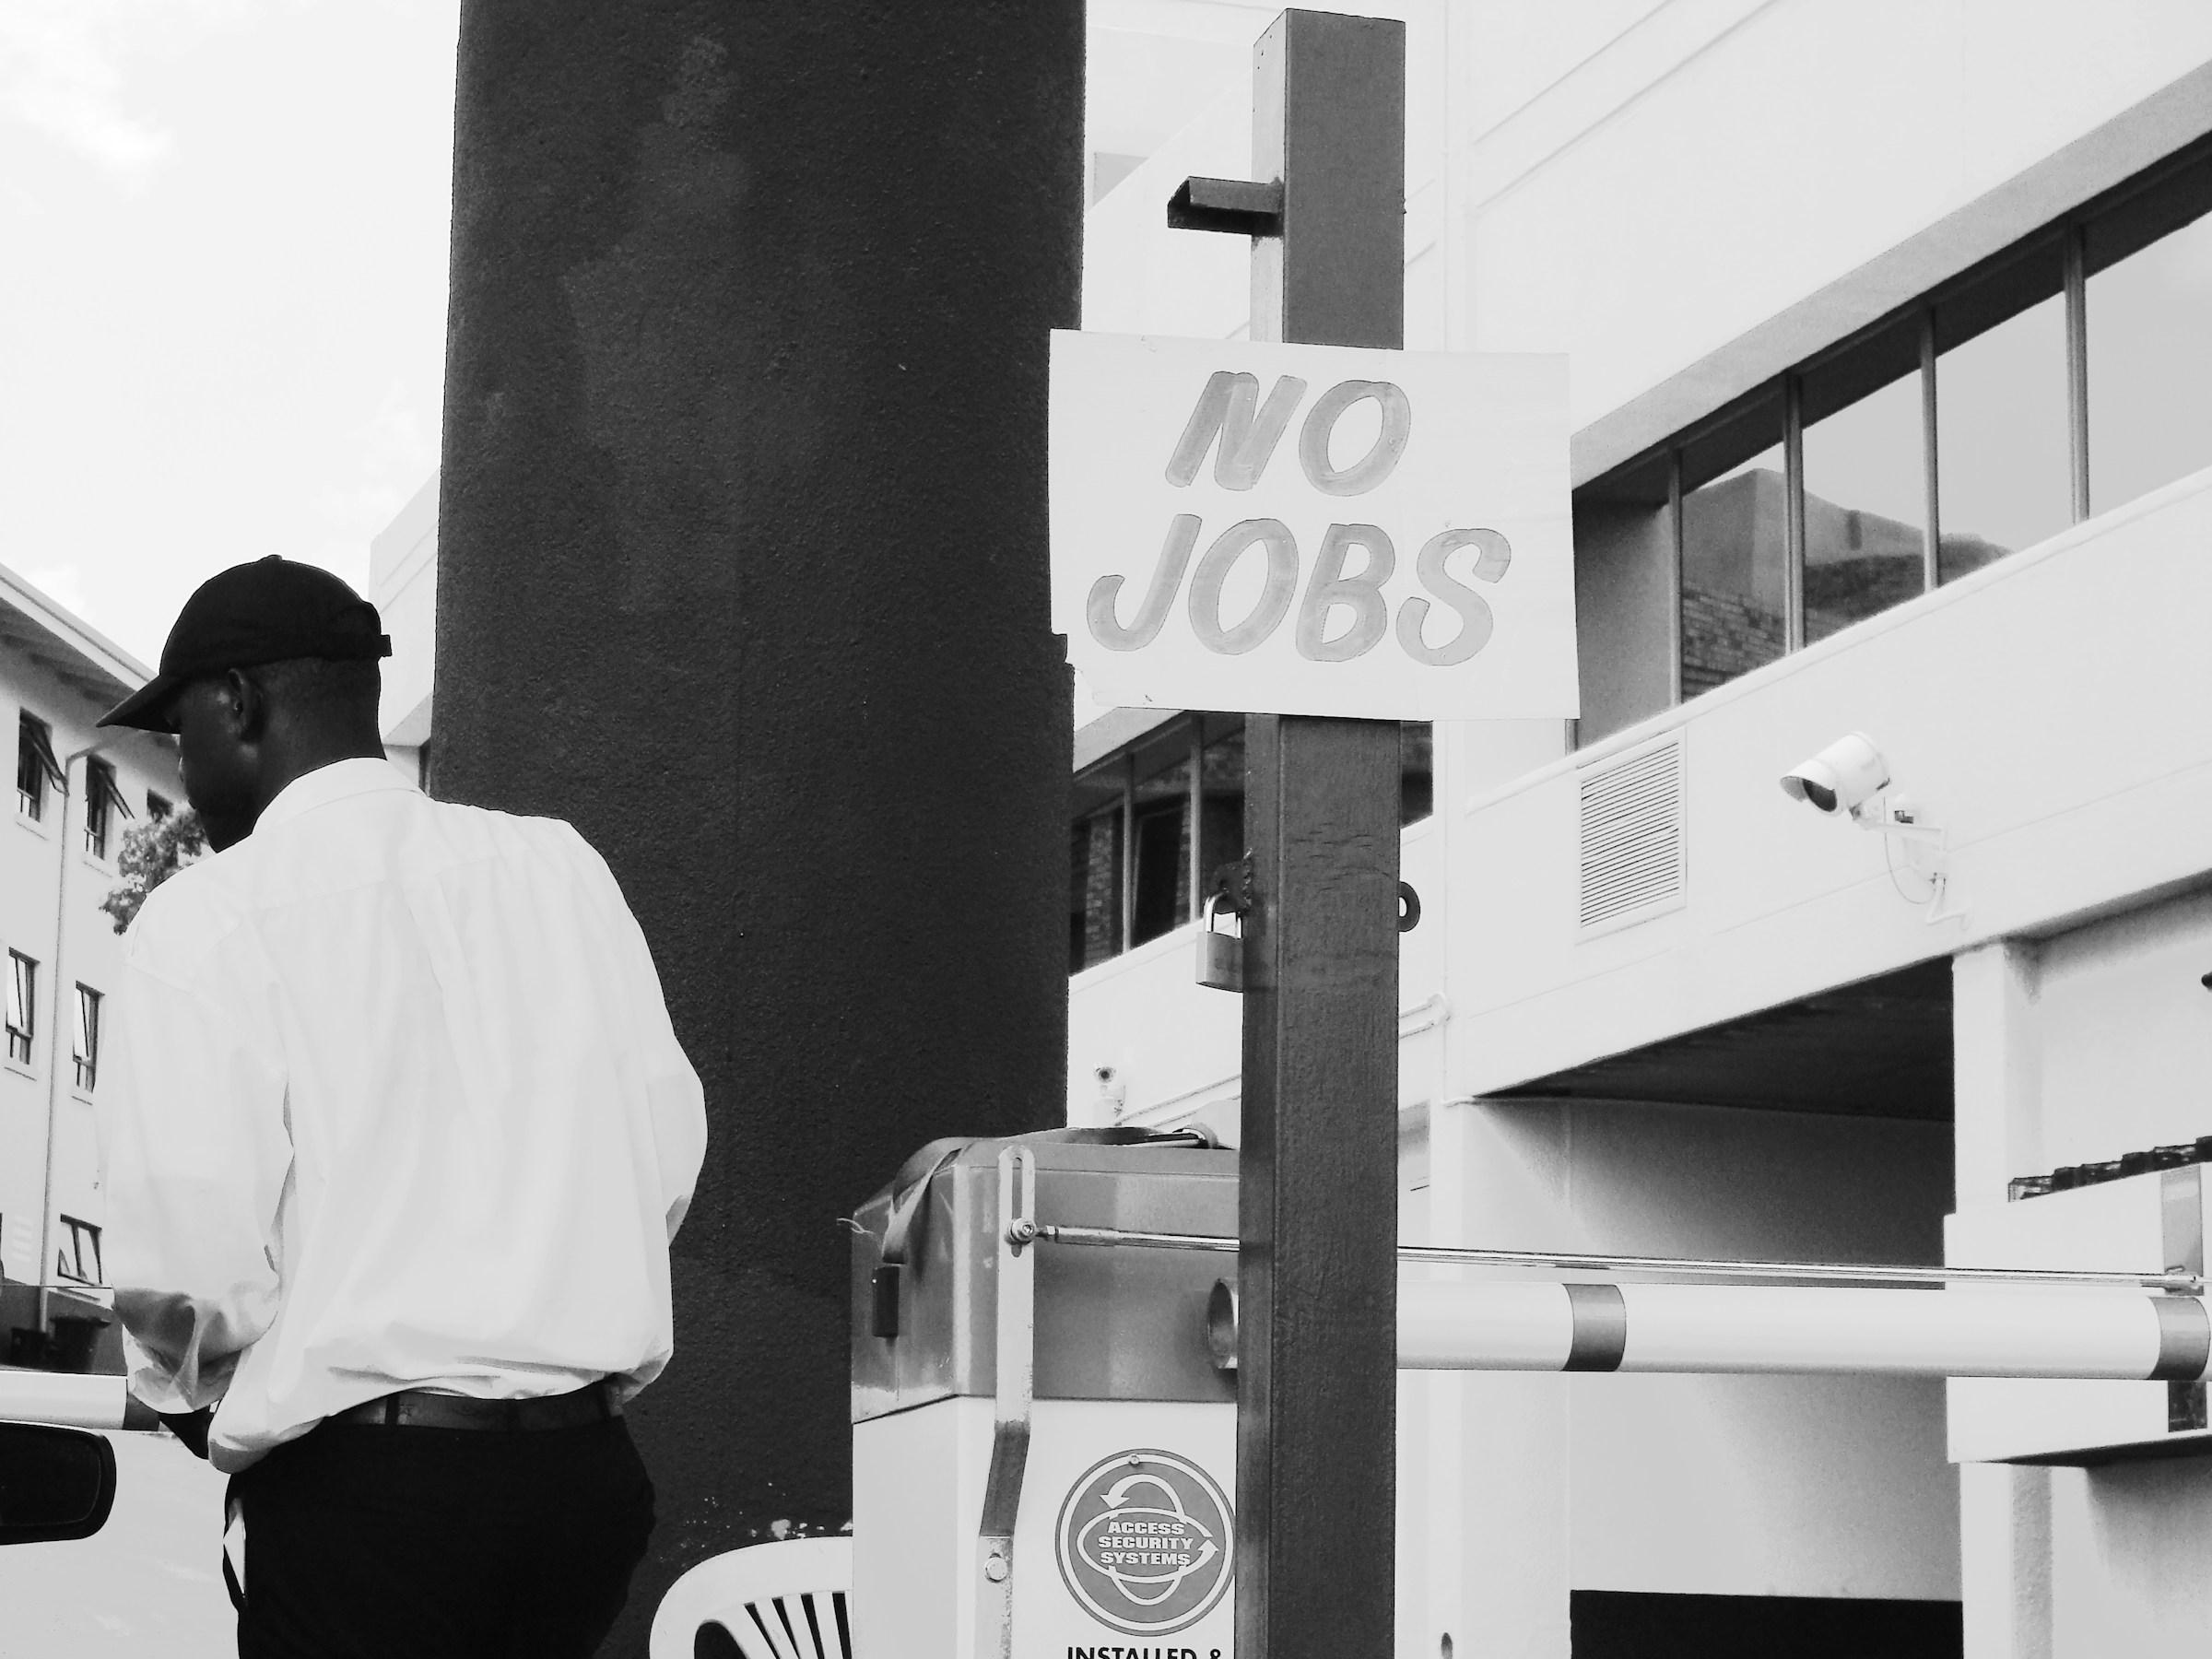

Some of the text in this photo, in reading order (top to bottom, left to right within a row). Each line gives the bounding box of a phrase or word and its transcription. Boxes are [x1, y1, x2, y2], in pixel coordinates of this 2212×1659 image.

[1165, 371, 1412, 497] NO
[1087, 513, 1512, 666] JOBS
[1107, 1521, 1185, 1535] ACCESS
[1098, 1535, 1194, 1550] SECURITY
[1100, 1551, 1191, 1566] SYSTEMS
